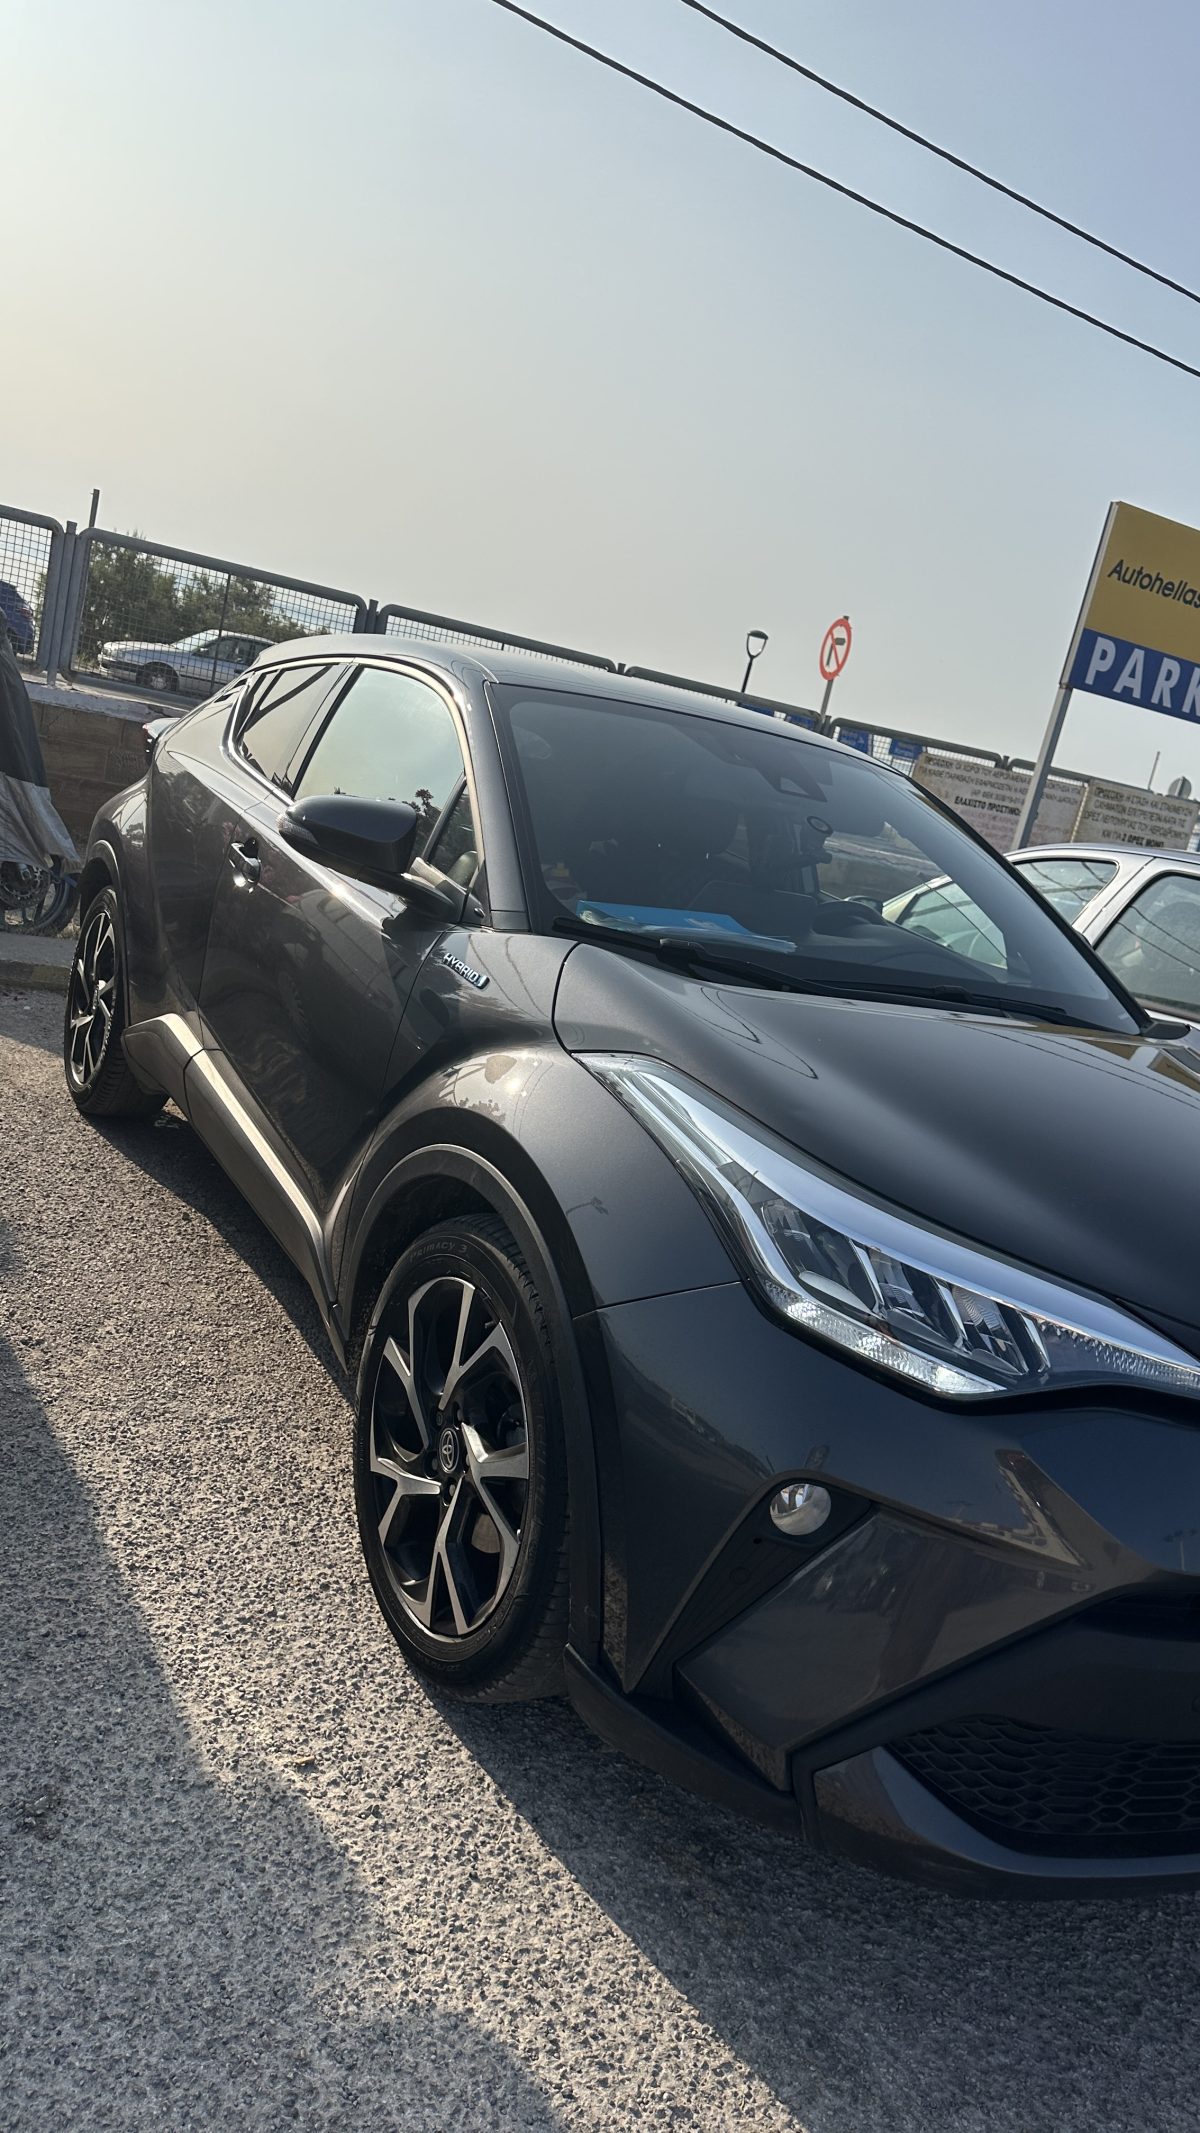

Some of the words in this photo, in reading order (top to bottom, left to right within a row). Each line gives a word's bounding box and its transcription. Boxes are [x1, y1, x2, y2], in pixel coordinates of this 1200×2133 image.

[1107, 559, 1200, 609] Autohellas
[954, 796, 986, 809] ΕΛΑΧΙΣΤΟ
[1126, 834, 1144, 844] ΩΡΕΣ
[443, 952, 480, 983] HYBRID
